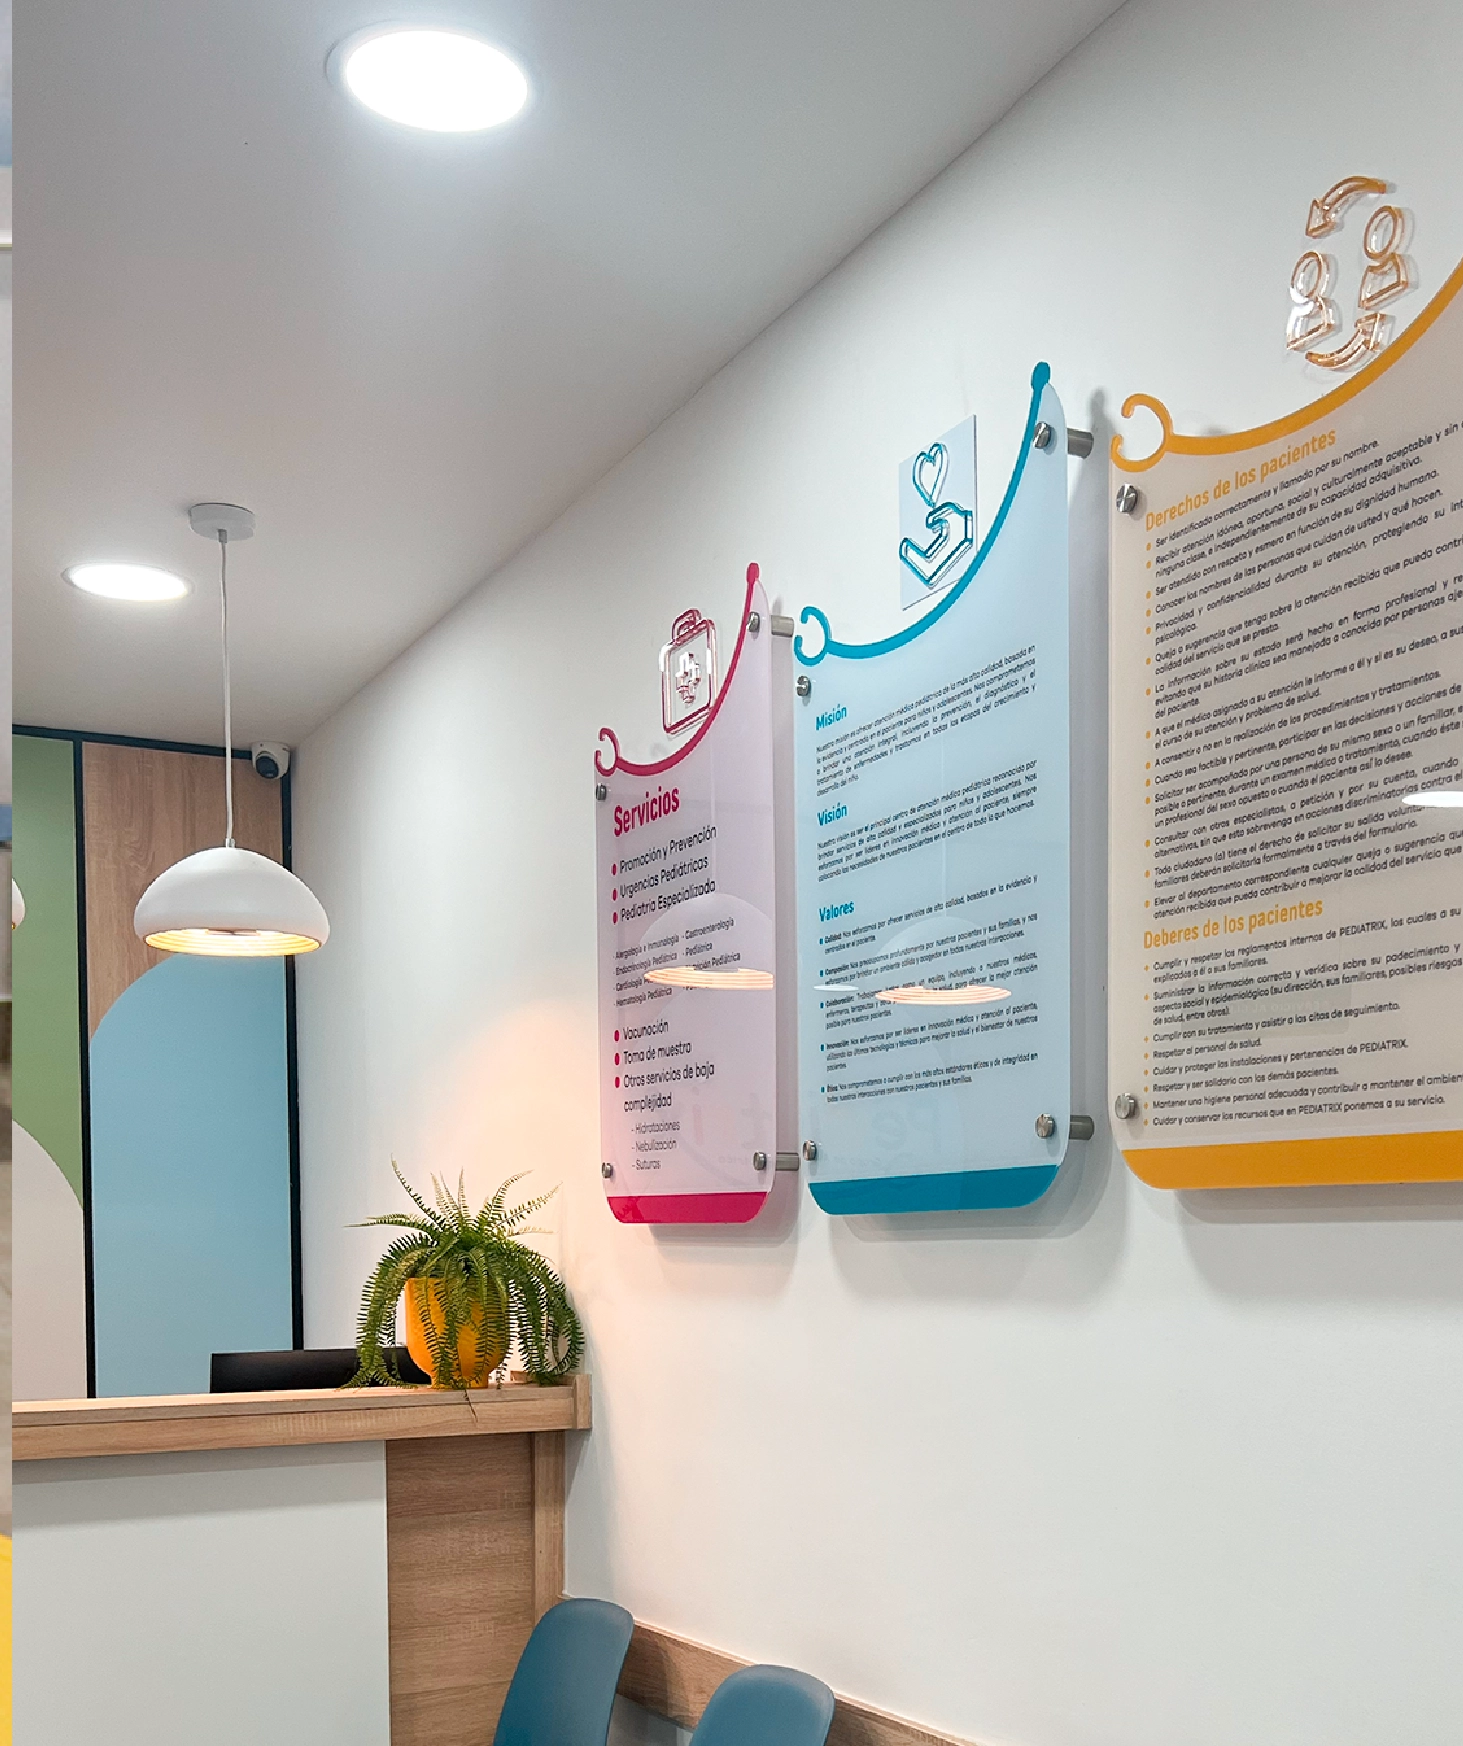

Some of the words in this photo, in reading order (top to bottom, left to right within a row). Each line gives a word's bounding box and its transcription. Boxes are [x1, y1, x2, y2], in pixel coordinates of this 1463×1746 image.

[1386, 436, 1433, 463] aceptable
[1436, 432, 1442, 443] y
[1444, 424, 1459, 437] sin
[1146, 491, 1210, 531] Derechos
[1213, 480, 1231, 500] de
[1235, 468, 1257, 490] los
[1261, 431, 1336, 482] pacientes
[1316, 462, 1331, 477] por
[1331, 458, 1343, 468] su
[1313, 559, 1323, 569] su
[1434, 508, 1446, 520] su
[1338, 616, 1349, 627] en
[1353, 605, 1381, 621] forma
[1386, 582, 1438, 611] profesional
[1443, 580, 1449, 591] y
[816, 704, 848, 731] Misión
[1348, 784, 1365, 797] por
[1369, 781, 1379, 791] su
[1383, 770, 1418, 786] cuenta,
[1423, 757, 1459, 775] cuando
[614, 787, 680, 837] Servicios
[817, 803, 848, 827] Visión
[620, 848, 662, 874] Promoción
[662, 847, 668, 861] y
[670, 826, 717, 853] Prevención
[620, 875, 659, 899] Urgencias
[661, 857, 708, 883] Pediátricas
[658, 879, 716, 910] Especializada
[819, 902, 855, 923] Valores
[1144, 926, 1199, 949] Deberes
[1203, 920, 1221, 939] de
[1224, 916, 1245, 934] los
[1249, 901, 1323, 934] pacientes
[1290, 934, 1324, 947] internos
[1326, 930, 1337, 940] de
[1340, 921, 1388, 937] PEDIATRIX,
[1450, 908, 1462, 918] su
[623, 1020, 669, 1041] Vacunación
[624, 1051, 645, 1065] Toma
[646, 1047, 656, 1062] de
[658, 1043, 692, 1058] muestra
[1185, 1062, 1217, 1074] proteger
[1290, 1048, 1345, 1062] pertenencias
[1347, 1045, 1358, 1055] de
[1360, 1039, 1409, 1053] PEDIATRIX.
[624, 1075, 646, 1089] Otros
[646, 1068, 682, 1085] servicios
[683, 1065, 694, 1080] de
[696, 1061, 715, 1080] baja
[624, 1093, 673, 1113] complejidad
[636, 1160, 662, 1171] Suturas
